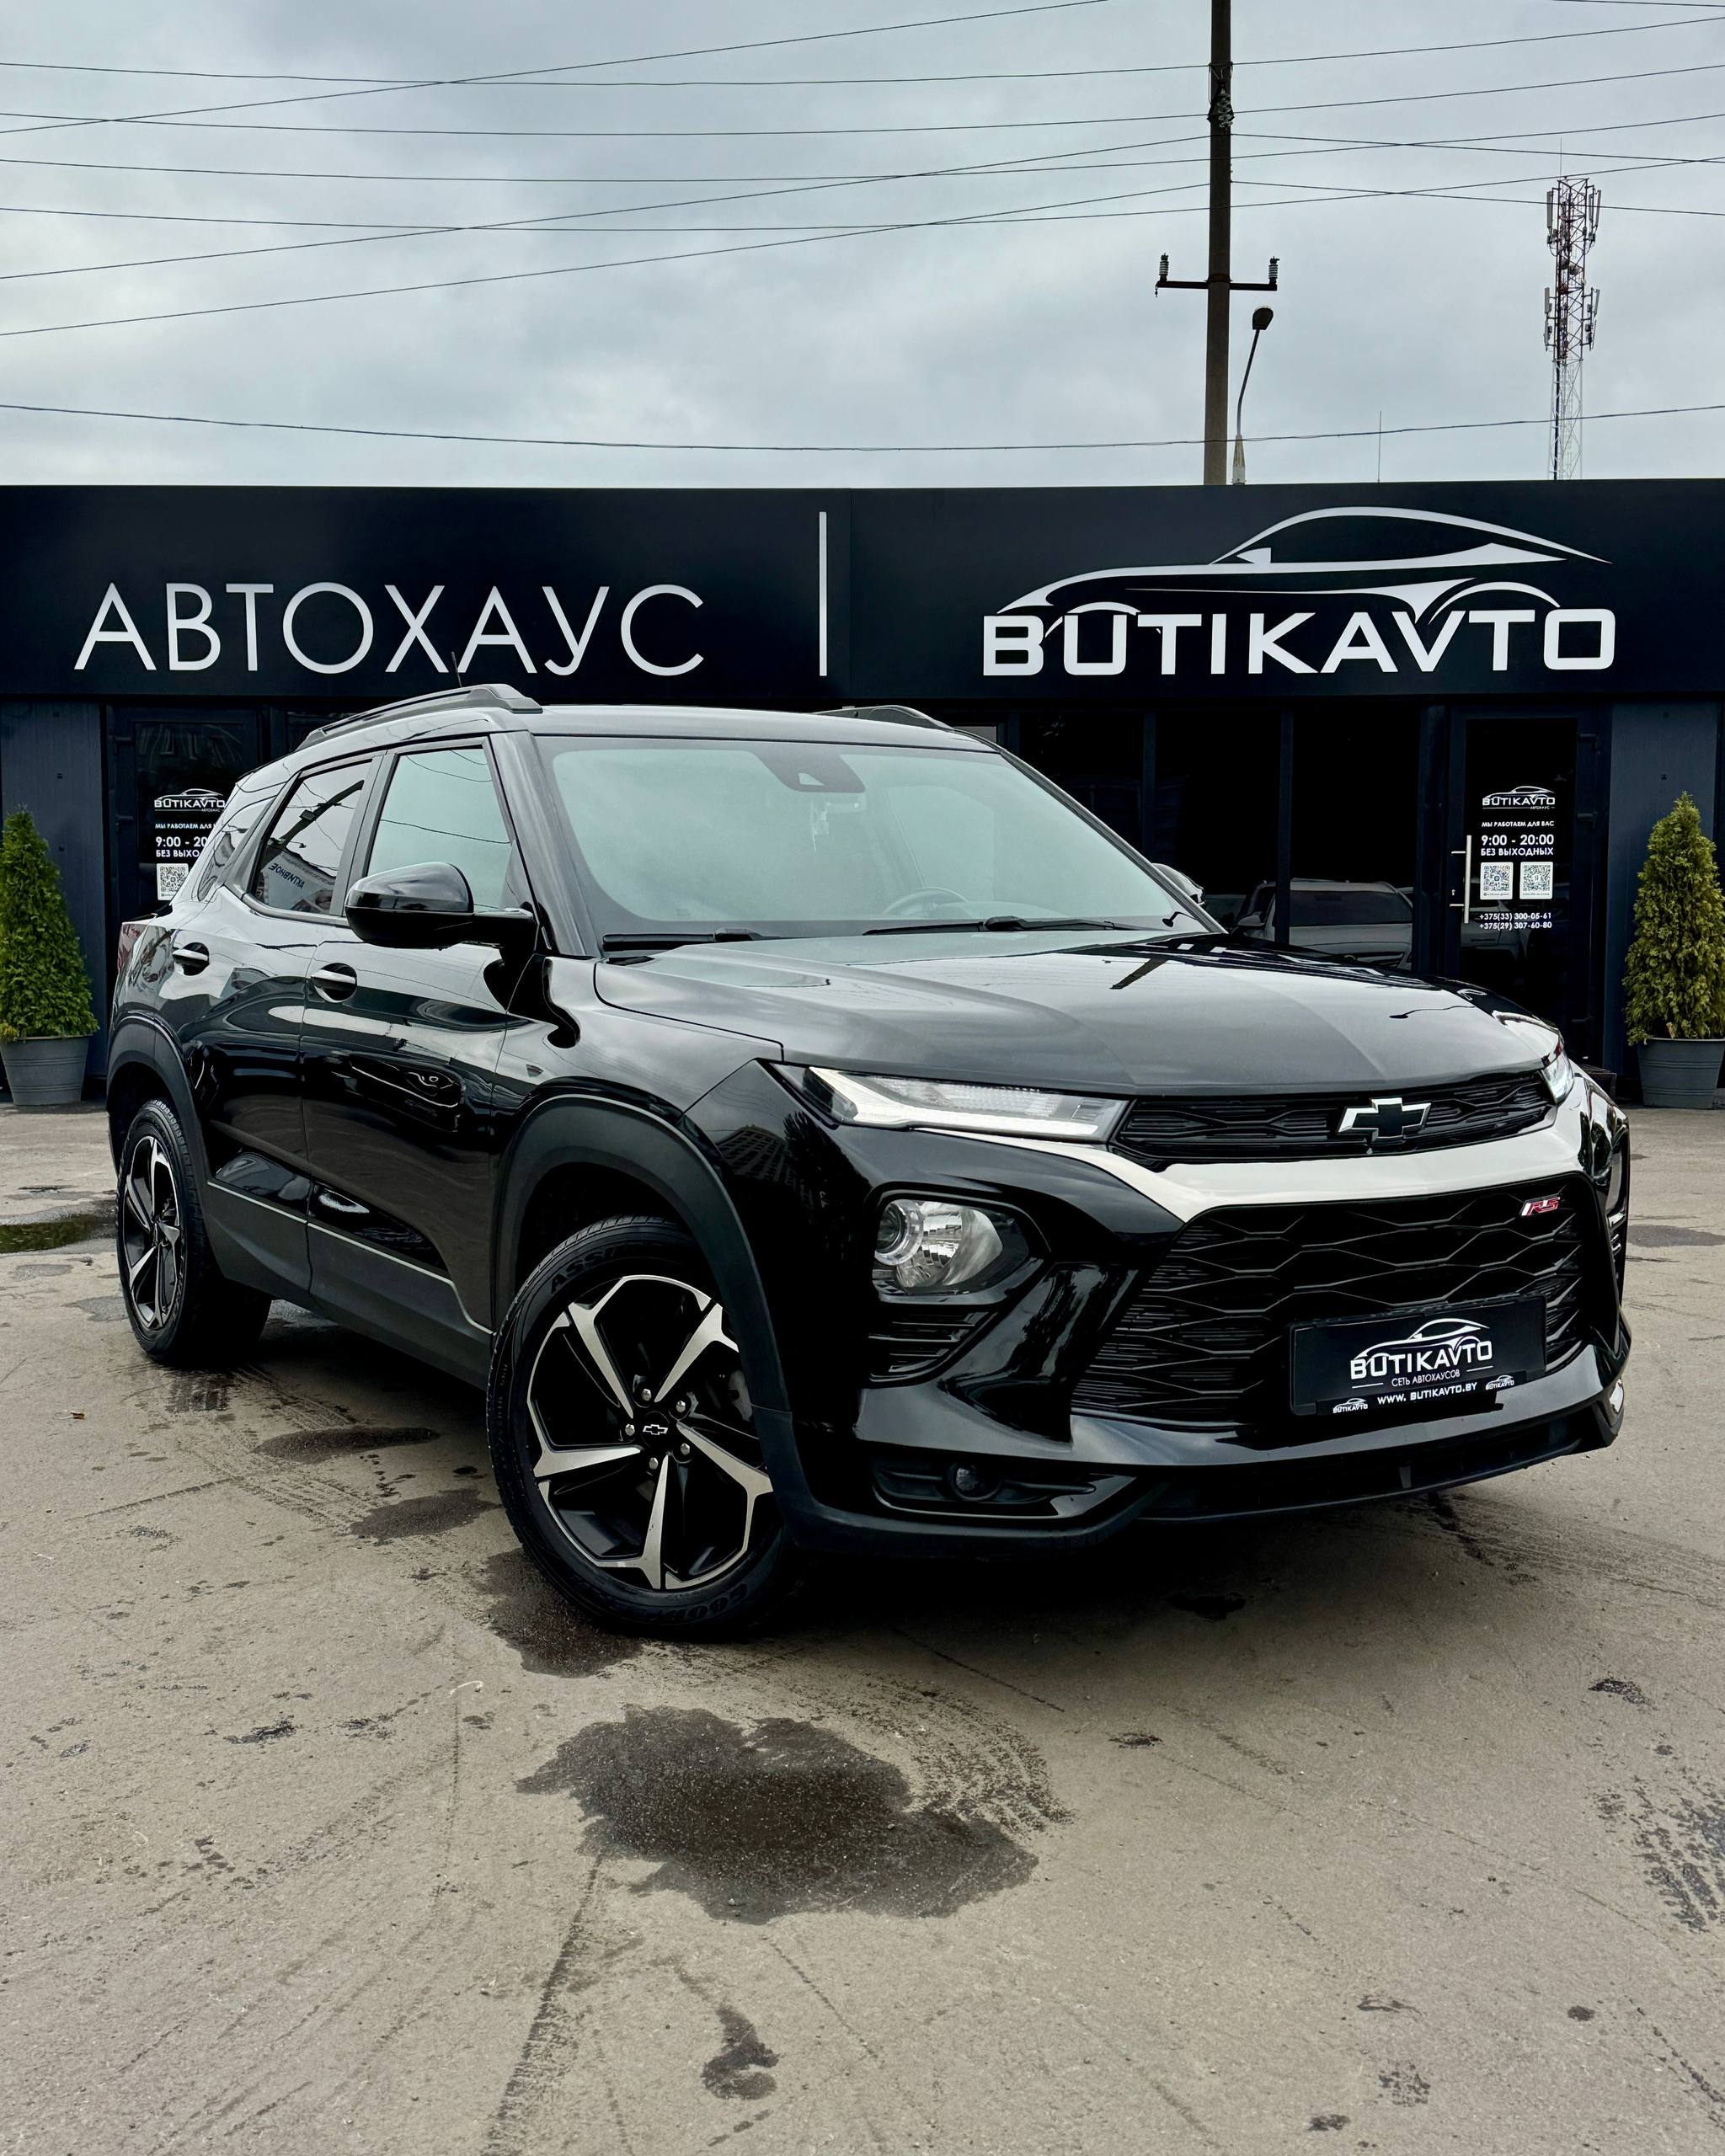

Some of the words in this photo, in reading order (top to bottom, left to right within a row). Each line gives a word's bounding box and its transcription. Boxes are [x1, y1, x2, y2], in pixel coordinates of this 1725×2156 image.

[74, 581, 704, 676] АВТОХАУС
[983, 607, 1616, 677] BUTIKAVTO
[154, 798, 225, 808] BUTIKAVTO
[1482, 797, 1555, 806] BUTIKAVTO
[155, 835, 181, 847] 9:00
[1481, 835, 1508, 846] 9:00
[1519, 834, 1555, 846] 20:00
[156, 849, 171, 857] БЕЗ
[173, 849, 200, 857] ВЫХО
[1481, 847, 1496, 857] БЕЗ
[1498, 847, 1554, 857] ВЫХОДНЫХ
[1479, 912, 1513, 921] +375(33)
[1514, 912, 1552, 921] 300-05-61
[1479, 921, 1513, 931] +375(29)
[1514, 921, 1553, 930] 307-60-80
[1525, 1196, 1561, 1217] RS
[1350, 1341, 1493, 1380] BUTIKAVTO
[1391, 1377, 1410, 1387] СЕТЬ
[1412, 1369, 1461, 1385] АВТОХАУСОВ
[1485, 1379, 1515, 1391] BUTIKAVTO
[1377, 1394, 1407, 1406] WWW.
[1410, 1382, 1478, 1401] BUTIKAVTO.BY
[1332, 1402, 1369, 1414] BUTIKAVTO
